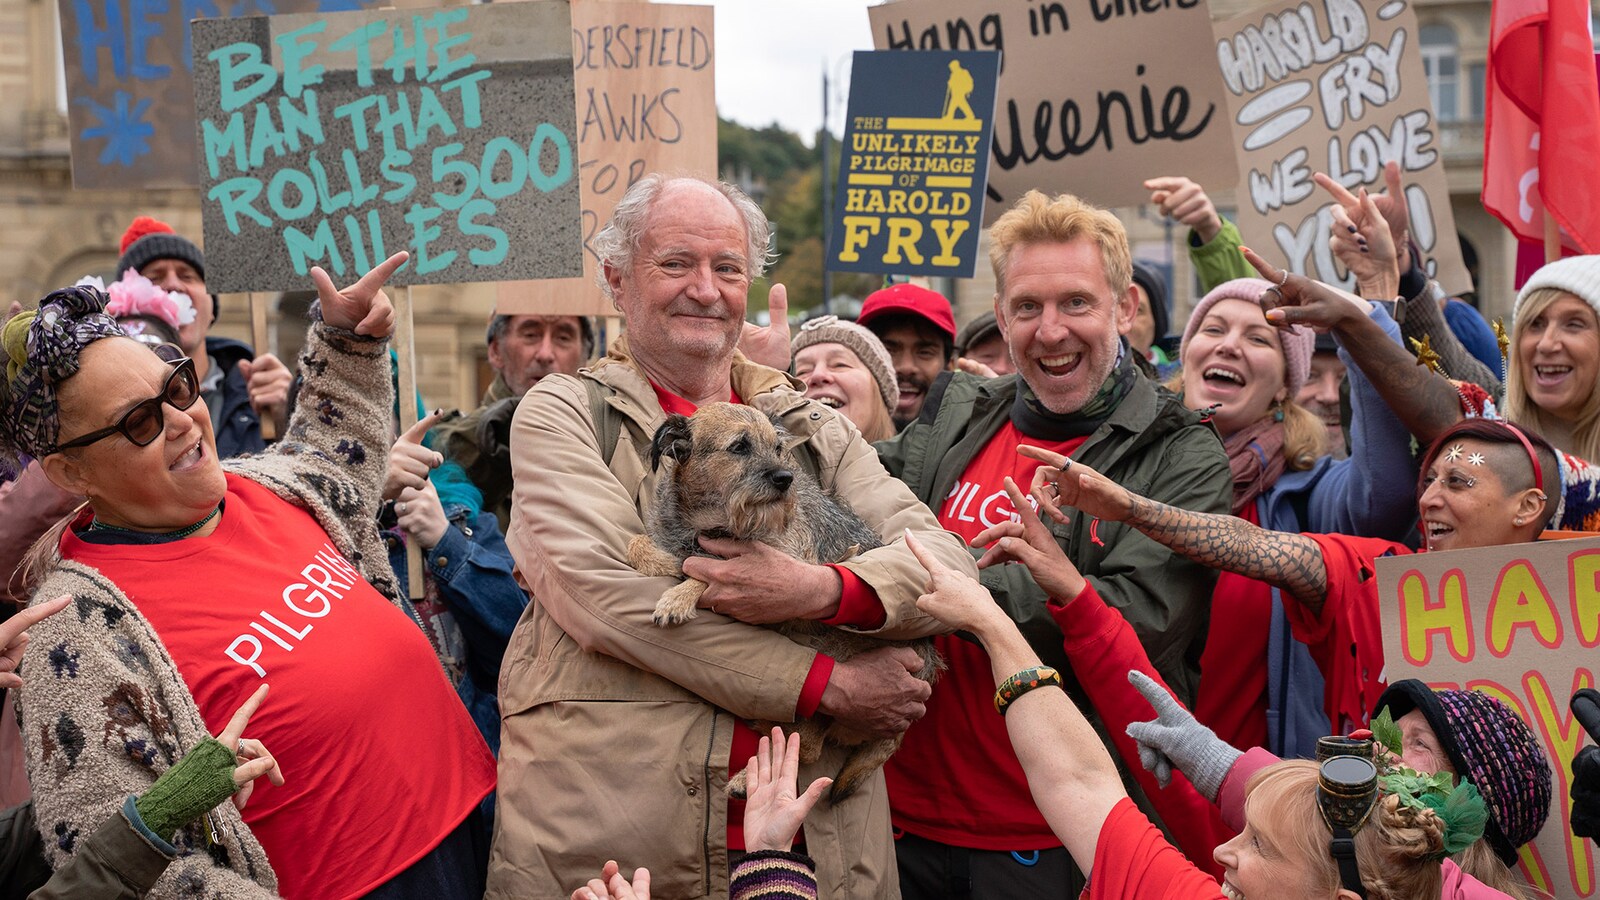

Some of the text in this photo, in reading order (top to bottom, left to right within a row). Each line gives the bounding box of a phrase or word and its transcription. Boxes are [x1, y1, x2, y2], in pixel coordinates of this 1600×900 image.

[208, 8, 477, 112] BE THE
[887, 13, 1004, 77] Hang
[1028, 0, 1070, 36] in
[1217, 0, 1370, 96] HAROLD
[1318, 27, 1407, 131] FRY
[202, 70, 492, 180] MAN THAT
[852, 133, 980, 154] UNLIKELY
[854, 117, 883, 130] THE
[986, 64, 1216, 202] ueenie
[1249, 146, 1316, 215] WE
[1327, 109, 1438, 190] LOVE
[208, 123, 573, 235] ROLLS 500
[845, 189, 972, 215] HAROLD
[850, 155, 976, 173] PILGRIMAGE
[898, 174, 920, 187] OF
[283, 200, 510, 277] MILES
[838, 216, 970, 267] FRY
